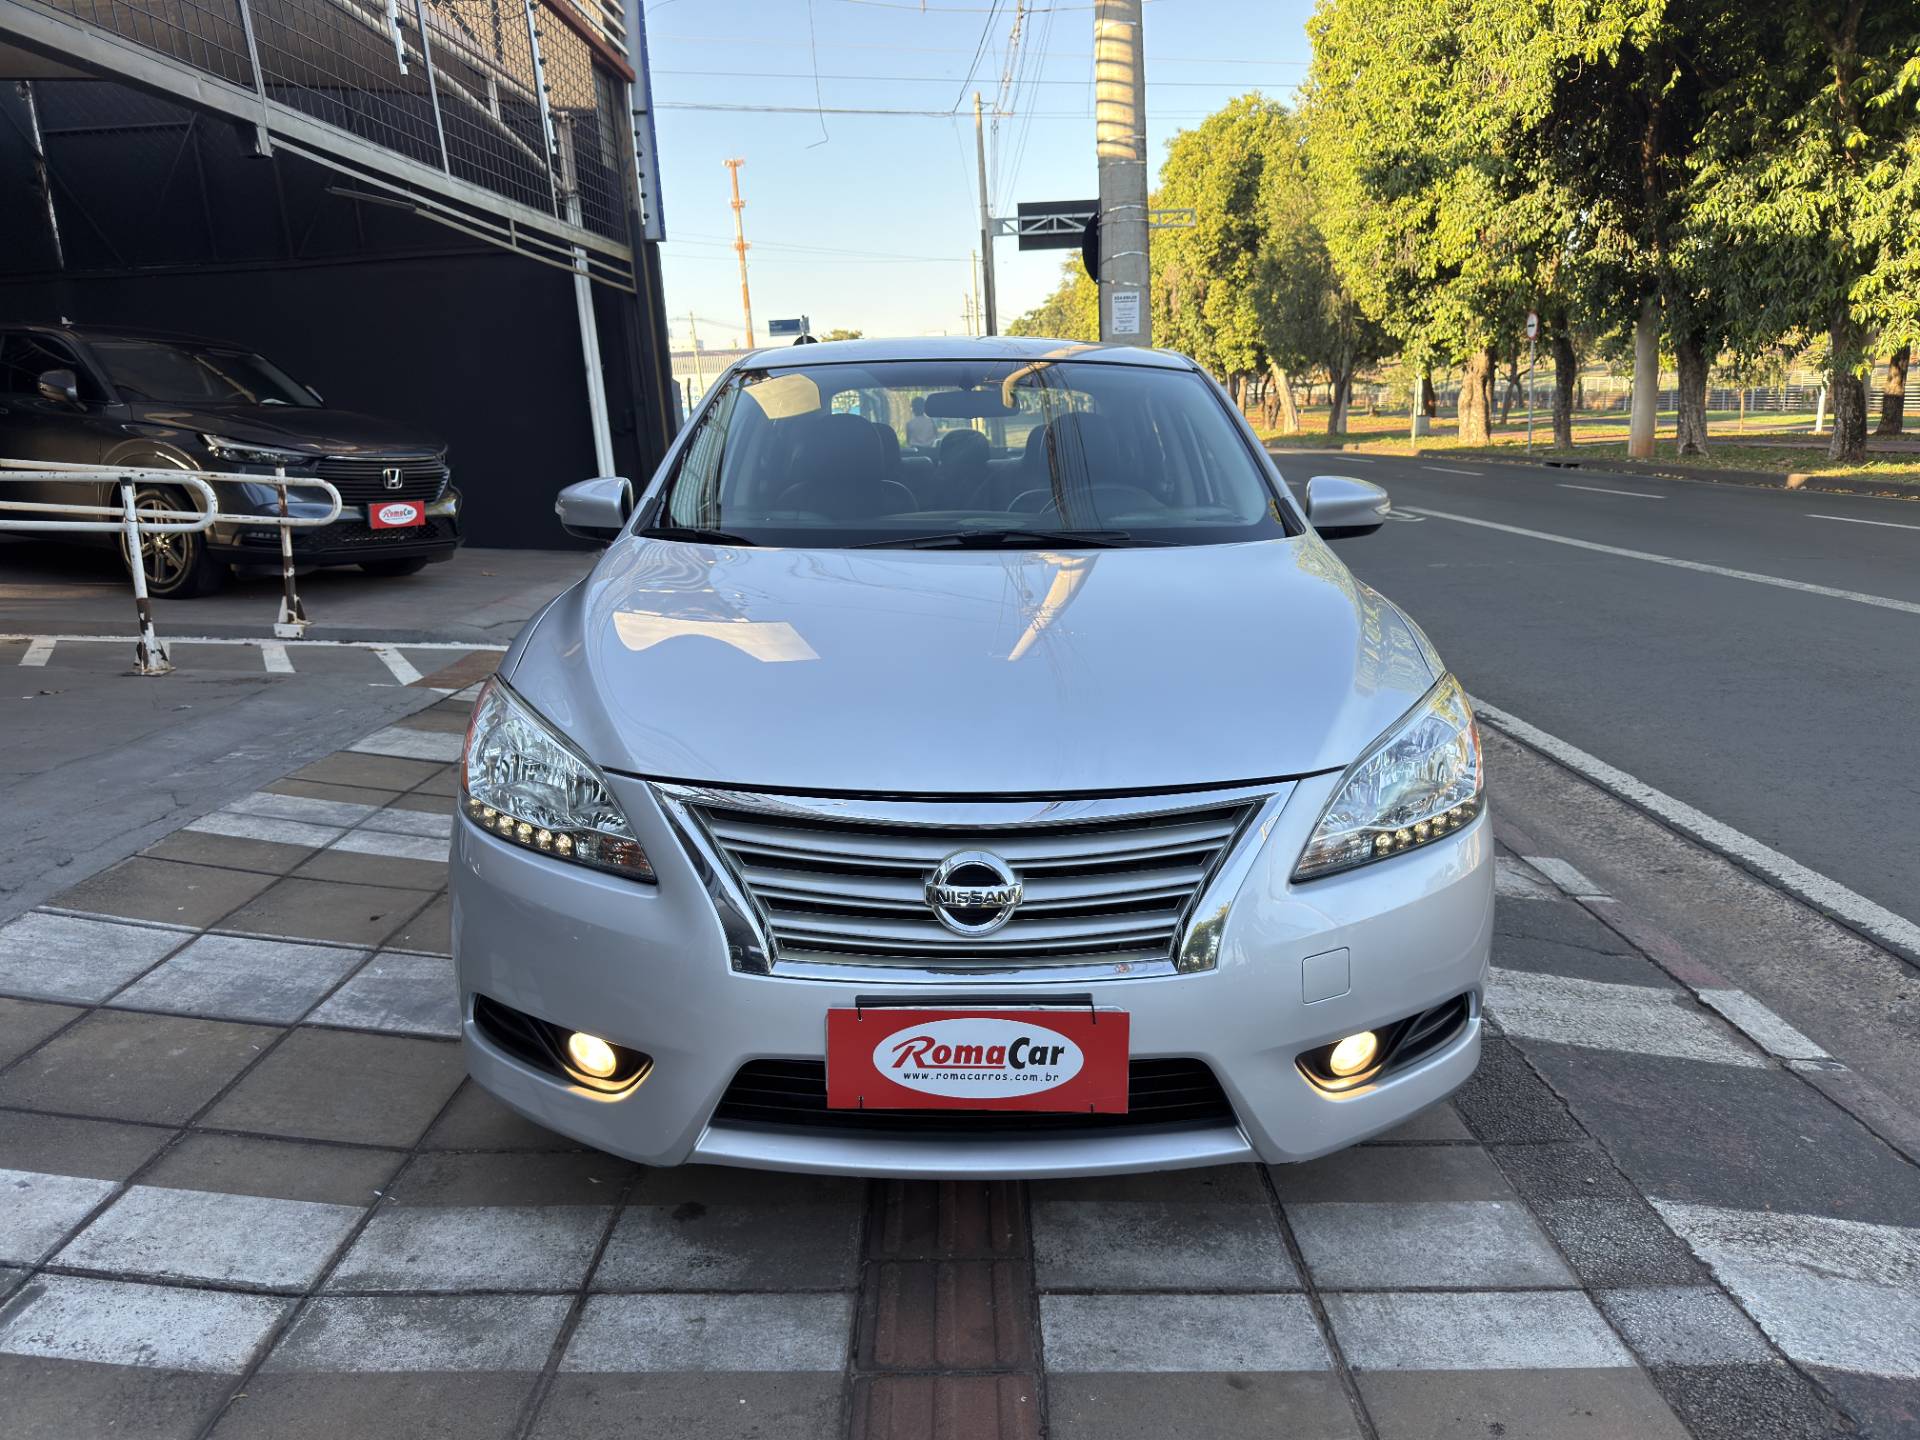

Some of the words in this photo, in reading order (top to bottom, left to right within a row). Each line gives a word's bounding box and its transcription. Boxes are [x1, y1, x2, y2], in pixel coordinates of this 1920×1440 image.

[935, 887, 1016, 905] NISSAN
[892, 1036, 1065, 1070] RomaCar
[903, 1072, 1059, 1082] www.romacarros.com.br
